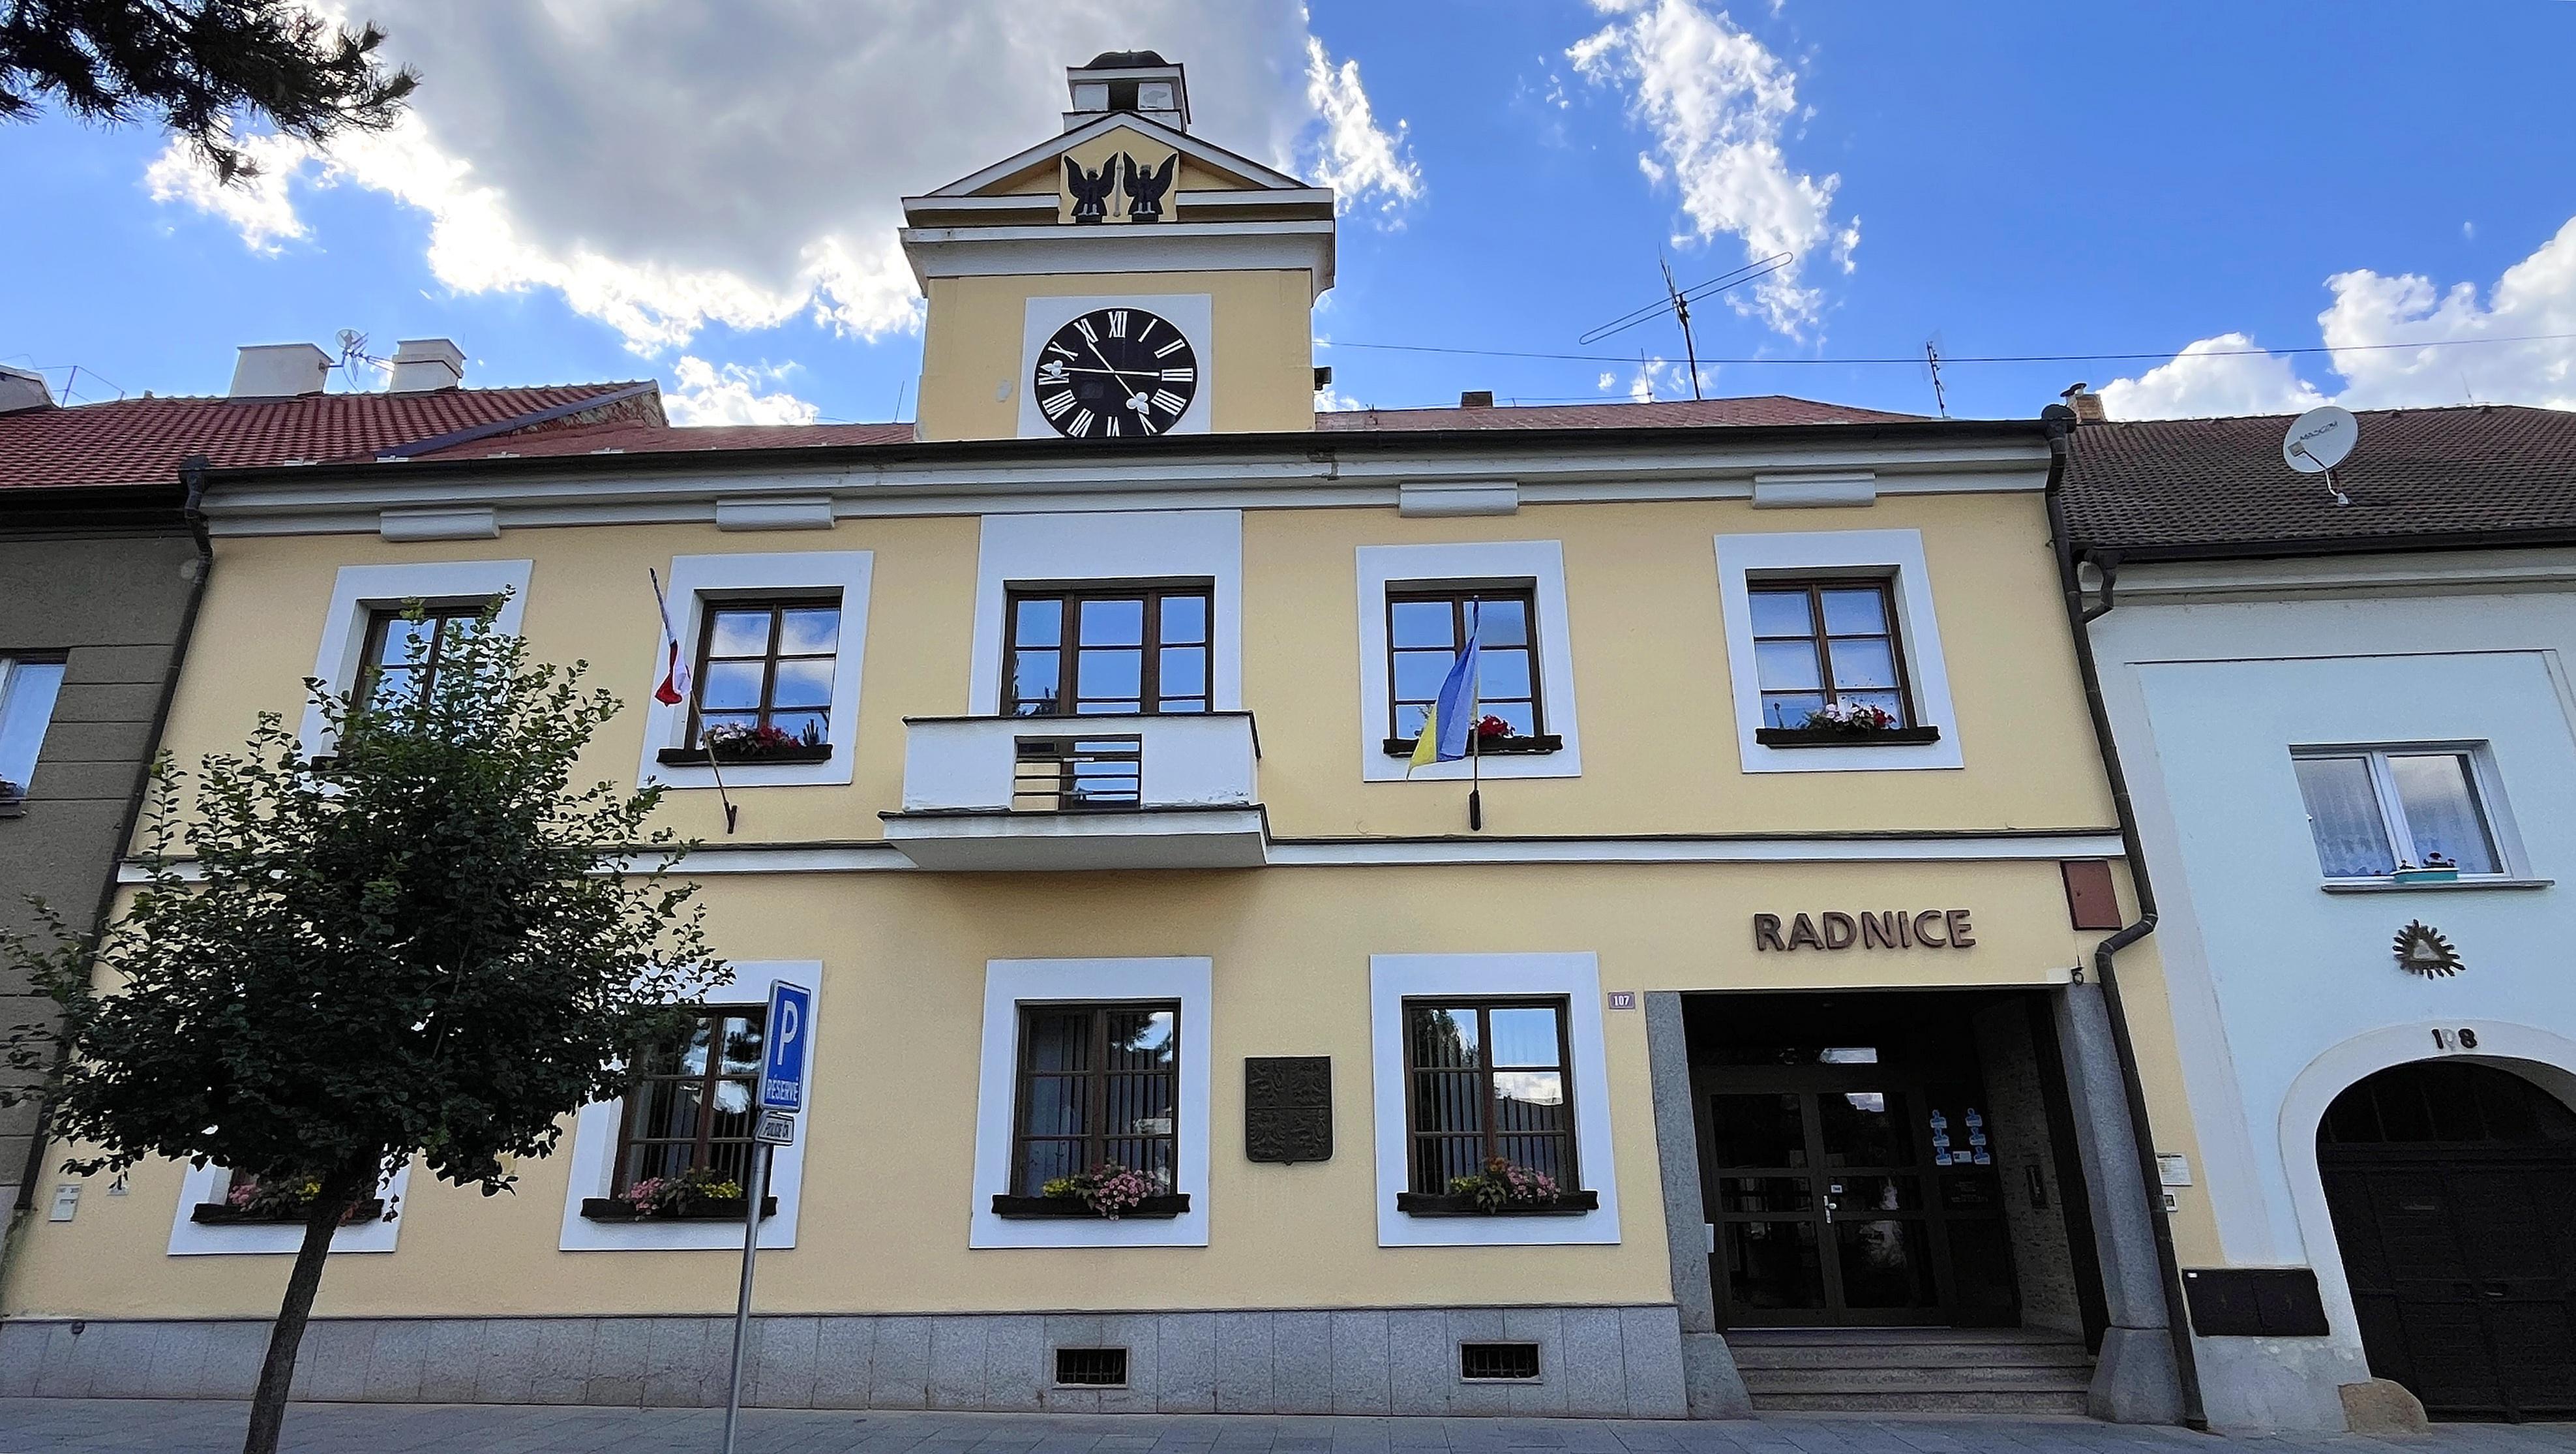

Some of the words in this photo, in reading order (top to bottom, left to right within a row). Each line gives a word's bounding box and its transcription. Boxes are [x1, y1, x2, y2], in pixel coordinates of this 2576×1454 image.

[1073, 318, 1099, 343] XI
[1108, 310, 1128, 338] XII
[1161, 367, 1194, 382] III
[1754, 909, 1977, 950] RADNICE
[1613, 995, 1630, 1006] 107
[777, 1000, 798, 1065] P
